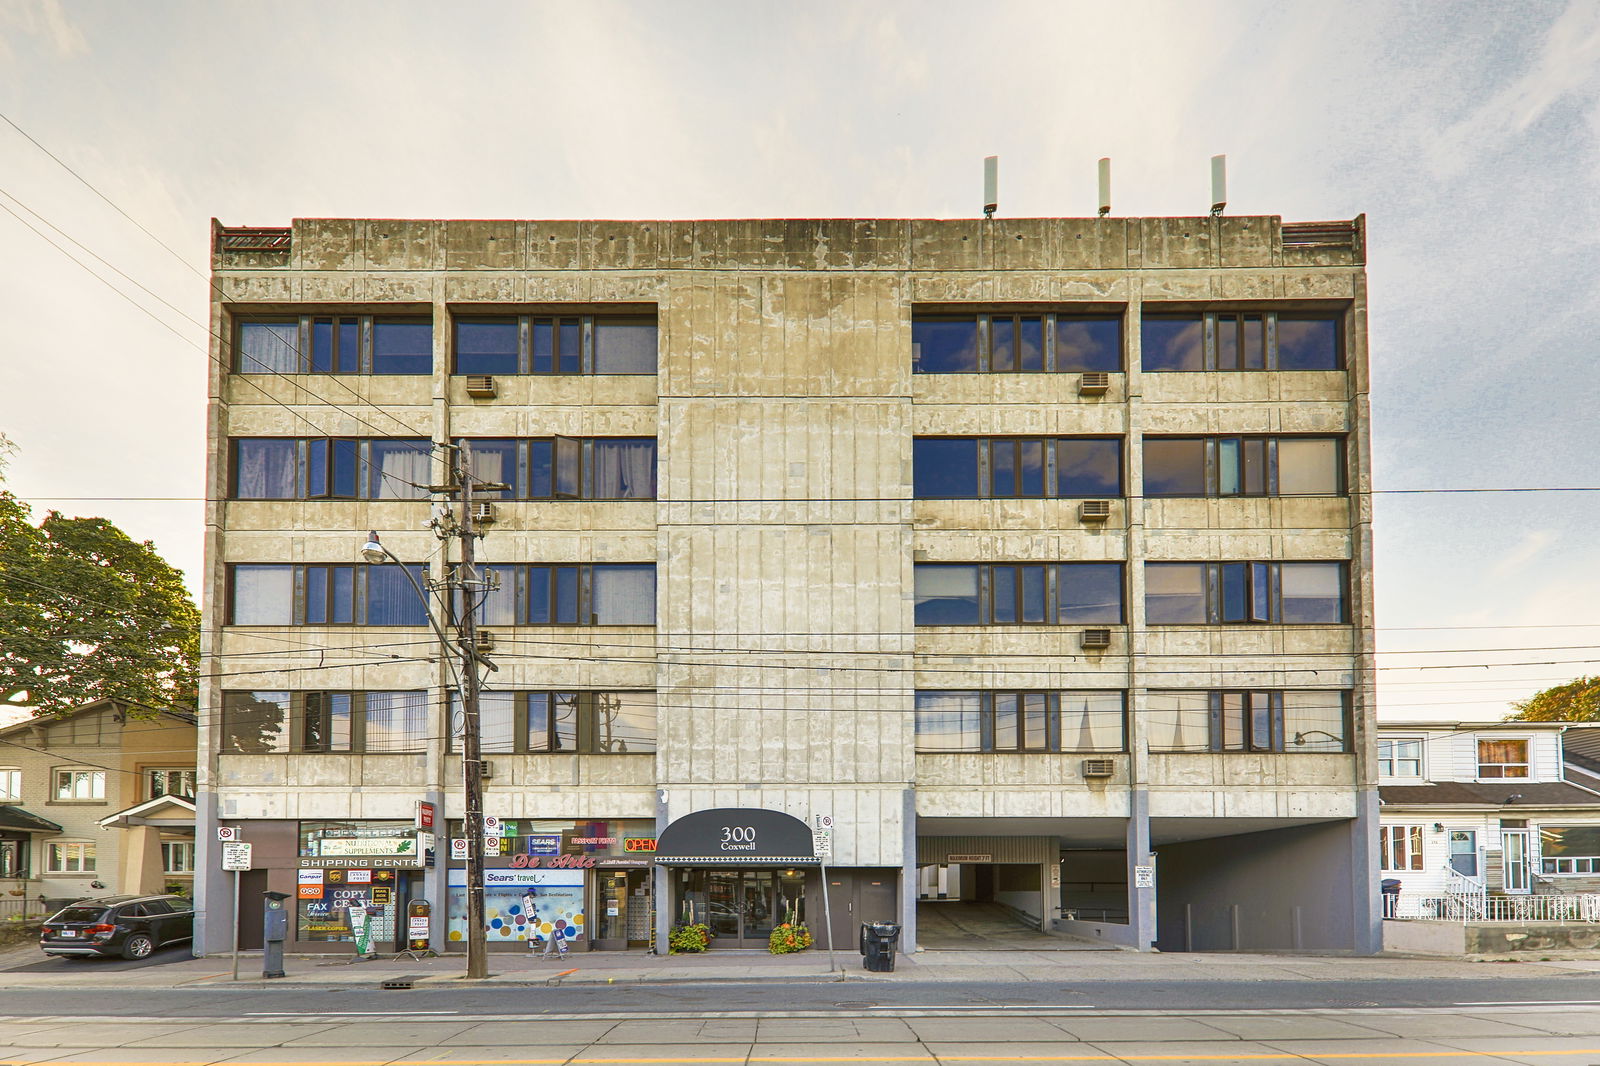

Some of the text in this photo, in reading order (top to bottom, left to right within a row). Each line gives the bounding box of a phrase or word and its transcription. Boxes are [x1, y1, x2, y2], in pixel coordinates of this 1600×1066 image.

[720, 826, 756, 842] 300
[625, 838, 657, 851] OPEN
[720, 842, 756, 851] Coxwell
[344, 847, 393, 855] SUPPLEMENTS
[301, 859, 419, 867] SHIPPING CENTR
[508, 853, 597, 869] De Arts
[299, 873, 323, 881] Canpar
[487, 873, 541, 883] Sears travel
[333, 890, 367, 899] COPY
[307, 903, 328, 911] FAX
[333, 899, 383, 908] CETR
